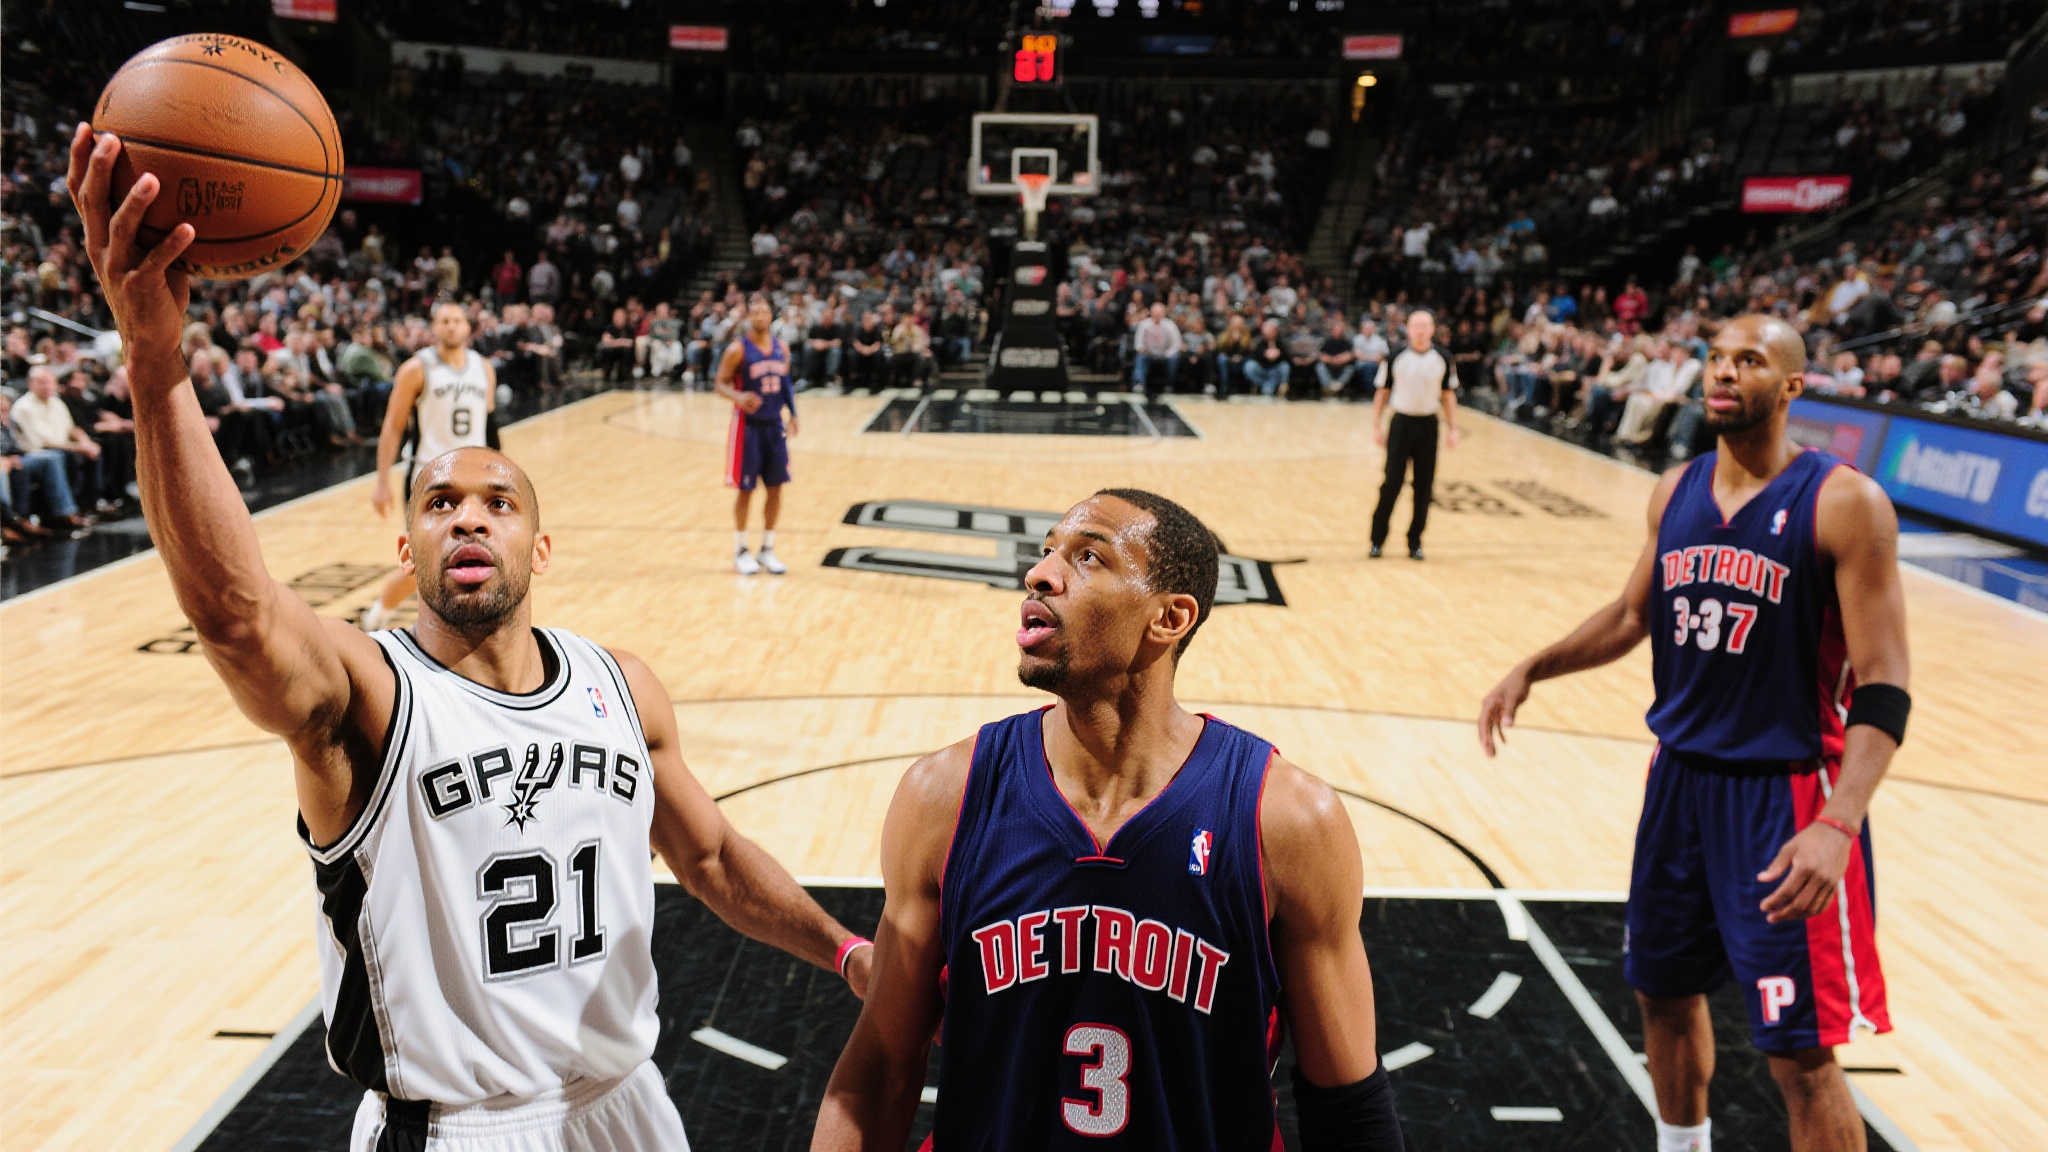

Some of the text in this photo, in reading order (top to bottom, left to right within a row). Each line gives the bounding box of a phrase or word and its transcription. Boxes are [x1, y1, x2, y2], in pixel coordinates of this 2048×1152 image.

[1660, 544, 1790, 604] DETROIT
[476, 838, 607, 983] 21
[972, 904, 1229, 1015] DETROIT
[1757, 976, 1796, 1023] P
[1060, 1022, 1132, 1138] 3
